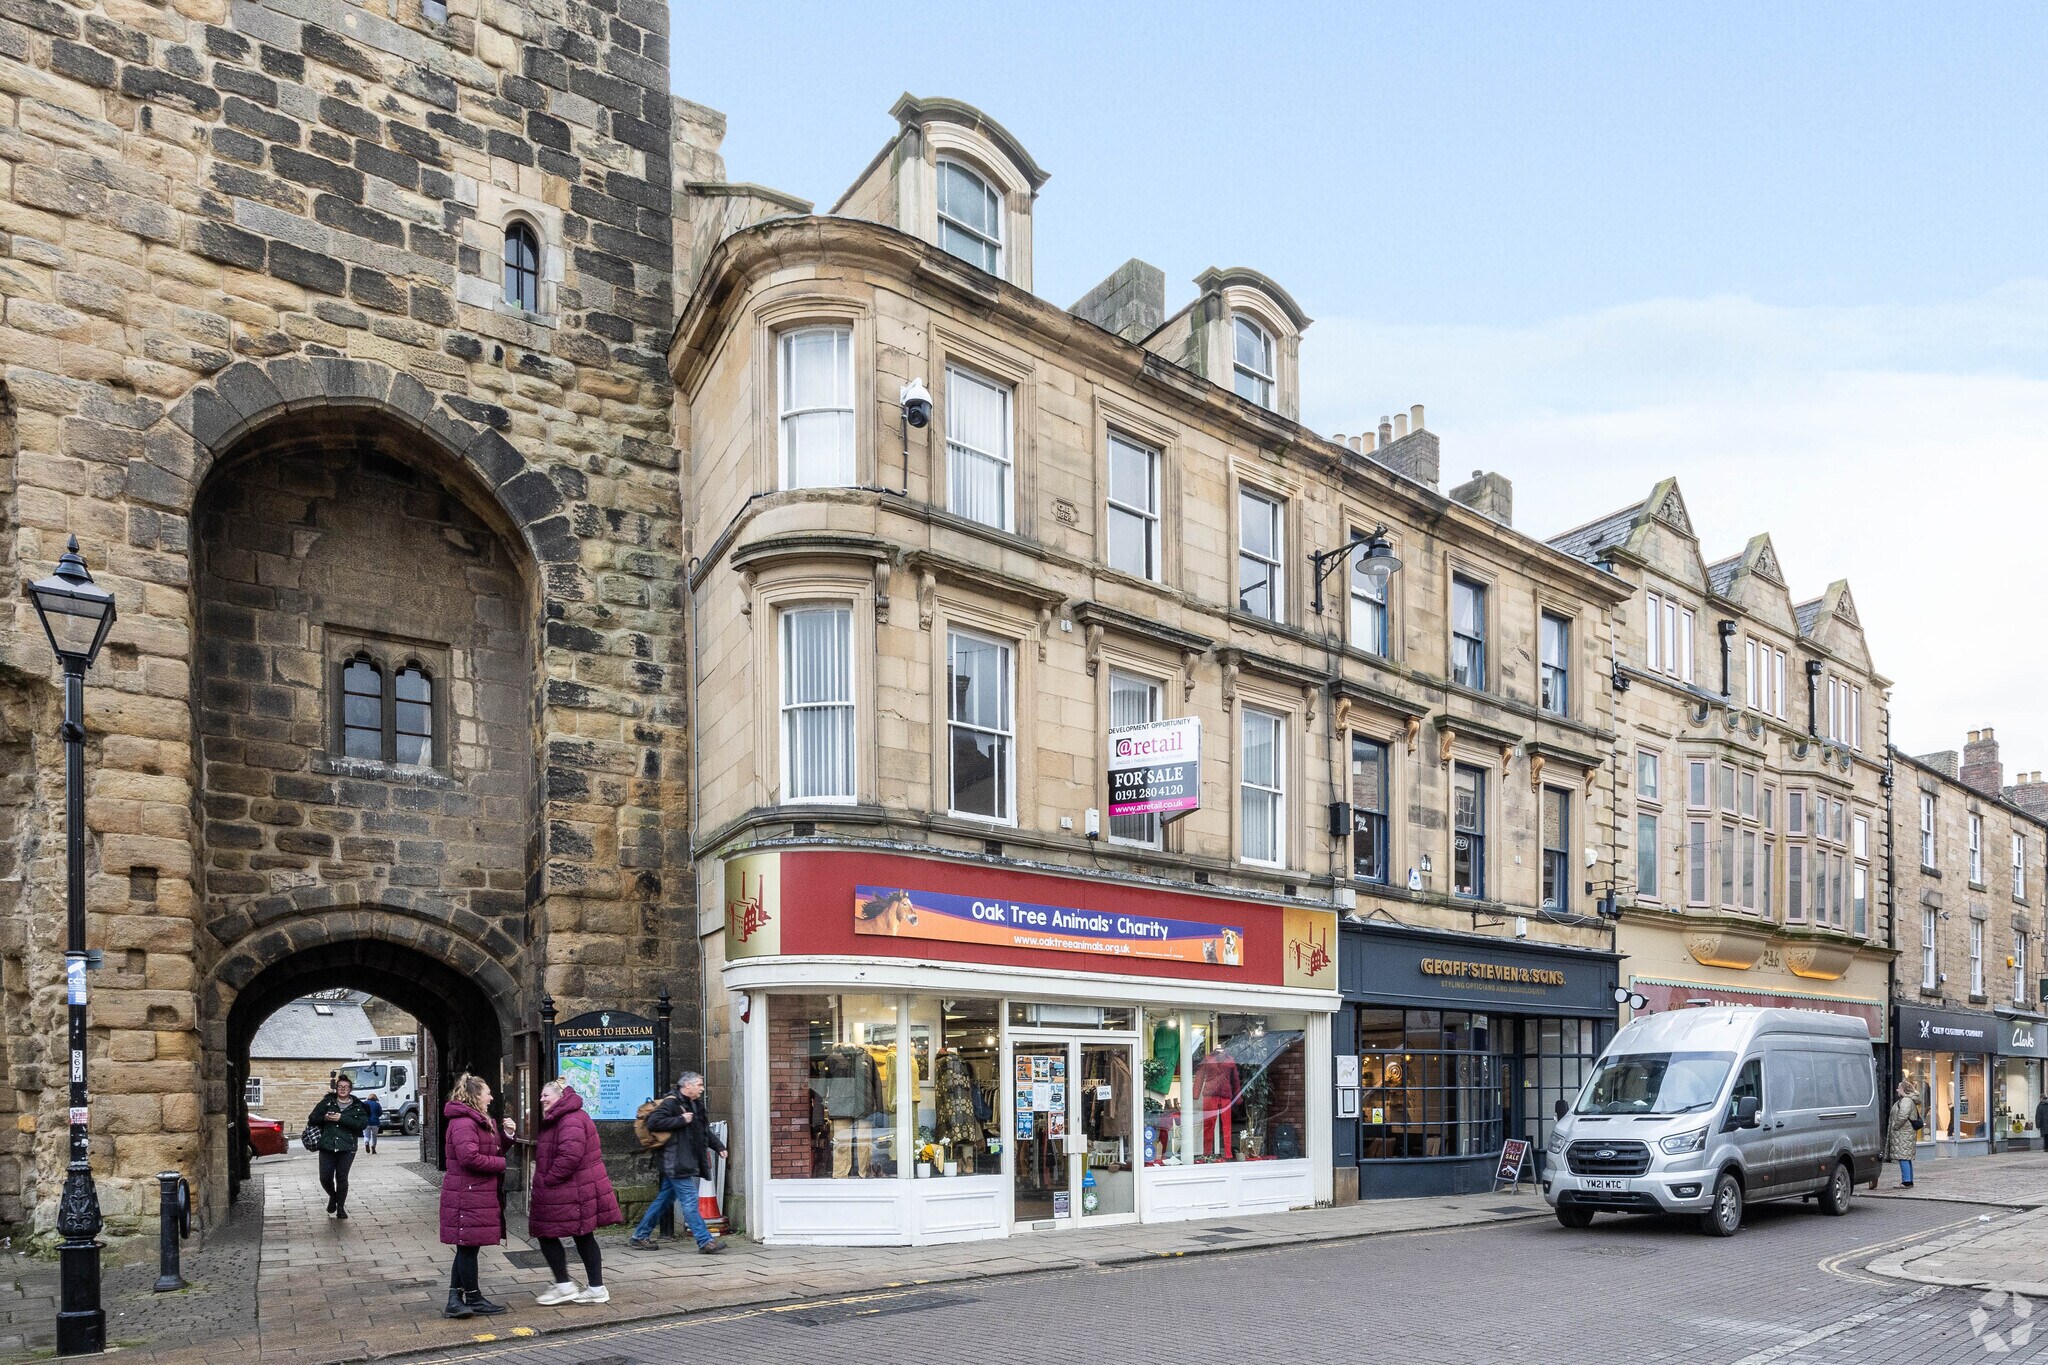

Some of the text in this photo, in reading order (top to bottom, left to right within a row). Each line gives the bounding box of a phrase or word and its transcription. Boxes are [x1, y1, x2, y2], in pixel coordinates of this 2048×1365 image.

[1108, 718, 1191, 734] DEVELOPMENT OPPORTUNITY
[1116, 731, 1184, 757] @retail
[1115, 767, 1184, 788] FOR SALE
[1115, 784, 1184, 801] 0191 280 4120
[1115, 799, 1184, 814] www.atretail.co.uk
[972, 901, 1169, 941] Oak Tree Animals' Charity
[1014, 935, 1131, 954] www.oaktreeanimals.org.uk
[1421, 957, 1469, 977] GEOFF
[1468, 962, 1519, 981] STEVEN
[1519, 967, 1530, 983] &
[1440, 980, 1465, 989] STYLING
[1465, 982, 1496, 992] OPTICIANS
[1496, 984, 1508, 993] AND
[559, 1026, 653, 1037] WELCOME TO HEXHAM
[2011, 1028, 2035, 1048] Clarks
[1505, 1153, 1520, 1161] SALE
